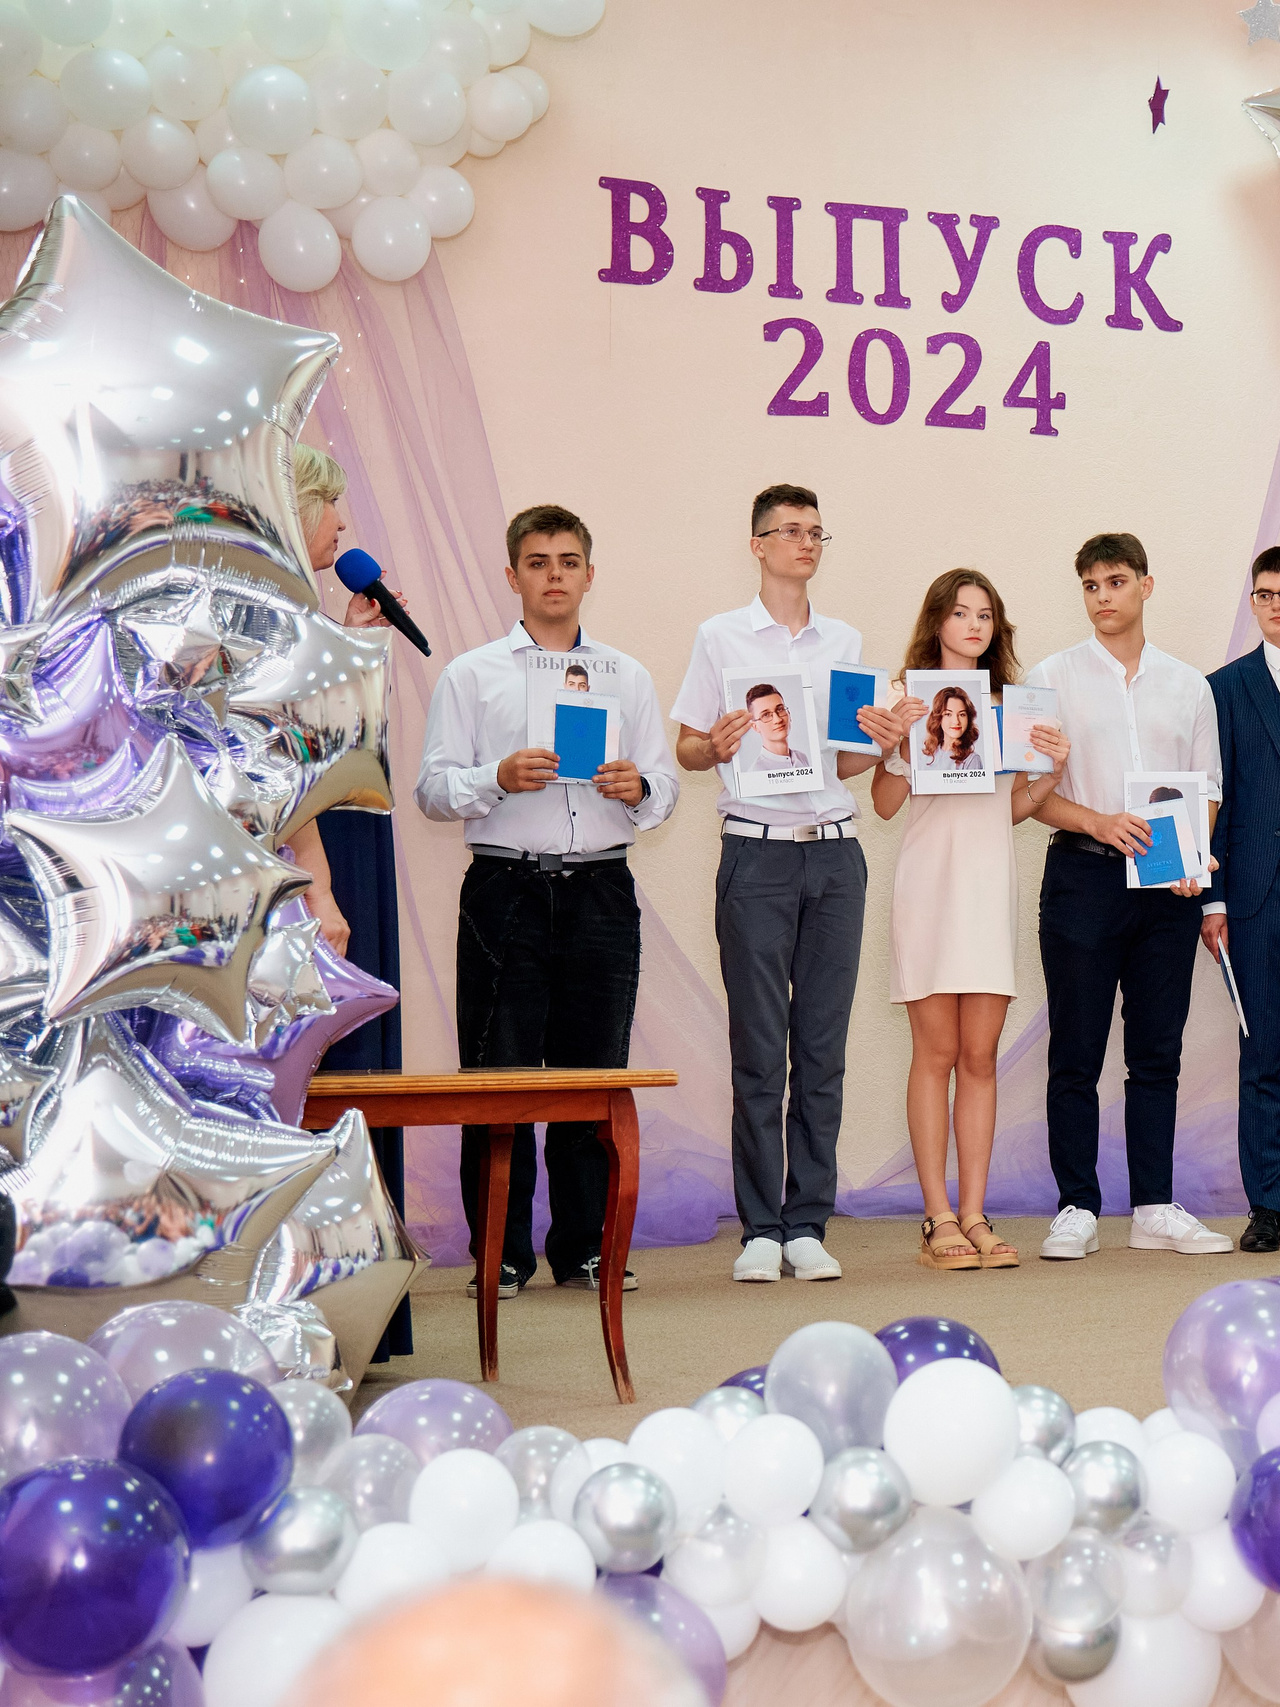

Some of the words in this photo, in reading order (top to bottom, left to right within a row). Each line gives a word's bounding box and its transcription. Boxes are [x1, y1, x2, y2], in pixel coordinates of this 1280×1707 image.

[597, 175, 1184, 333] ВЫПУСК
[763, 316, 1067, 437] 2024
[767, 771, 795, 779] выпуск
[795, 768, 814, 776] 2024
[942, 772, 969, 780] выпуск
